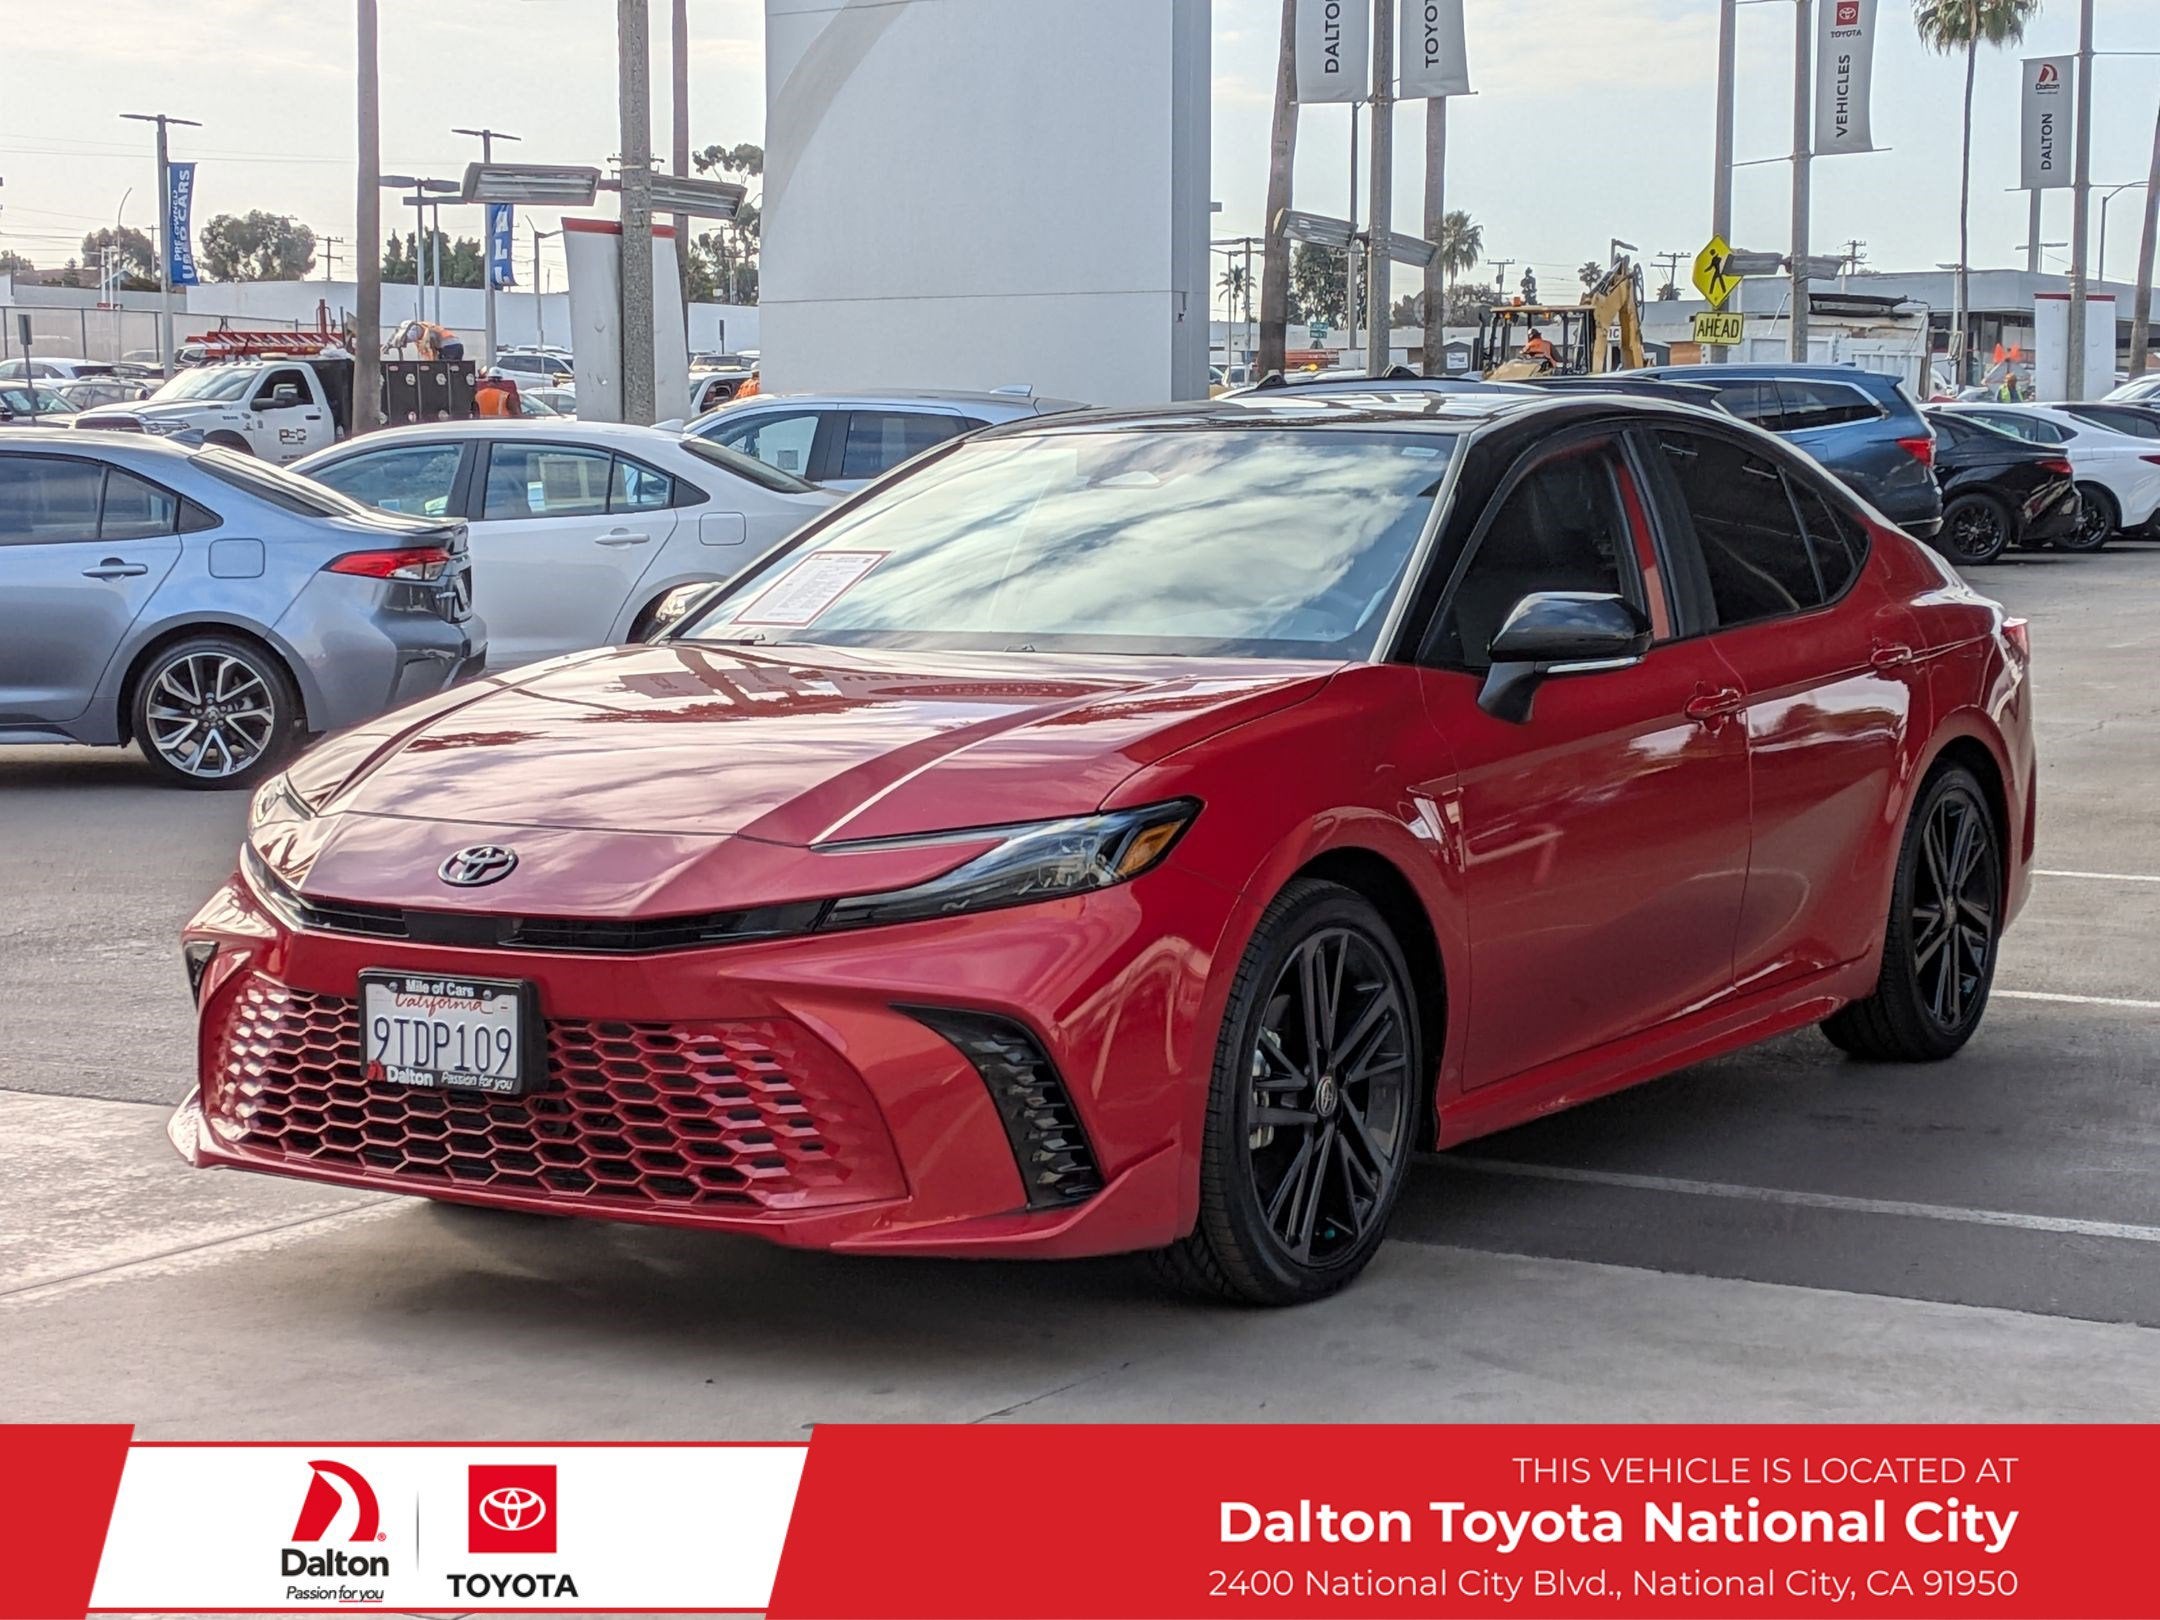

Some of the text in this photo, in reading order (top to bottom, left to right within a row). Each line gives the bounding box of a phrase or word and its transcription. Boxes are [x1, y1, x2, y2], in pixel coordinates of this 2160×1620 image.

[1324, 0, 1340, 74] DALTO
[1830, 29, 1862, 38] TOYOTA
[1836, 54, 1851, 138] VEHICLES
[2041, 113, 2053, 170] DALTON
[178, 169, 190, 222] CARS
[1697, 317, 1740, 339] AHEAD
[405, 979, 474, 997] Mile of Cars
[395, 992, 494, 1018] California
[374, 1016, 512, 1074] 9TDP109
[386, 1065, 433, 1087] Dalton
[441, 1071, 513, 1091] Passion for you
